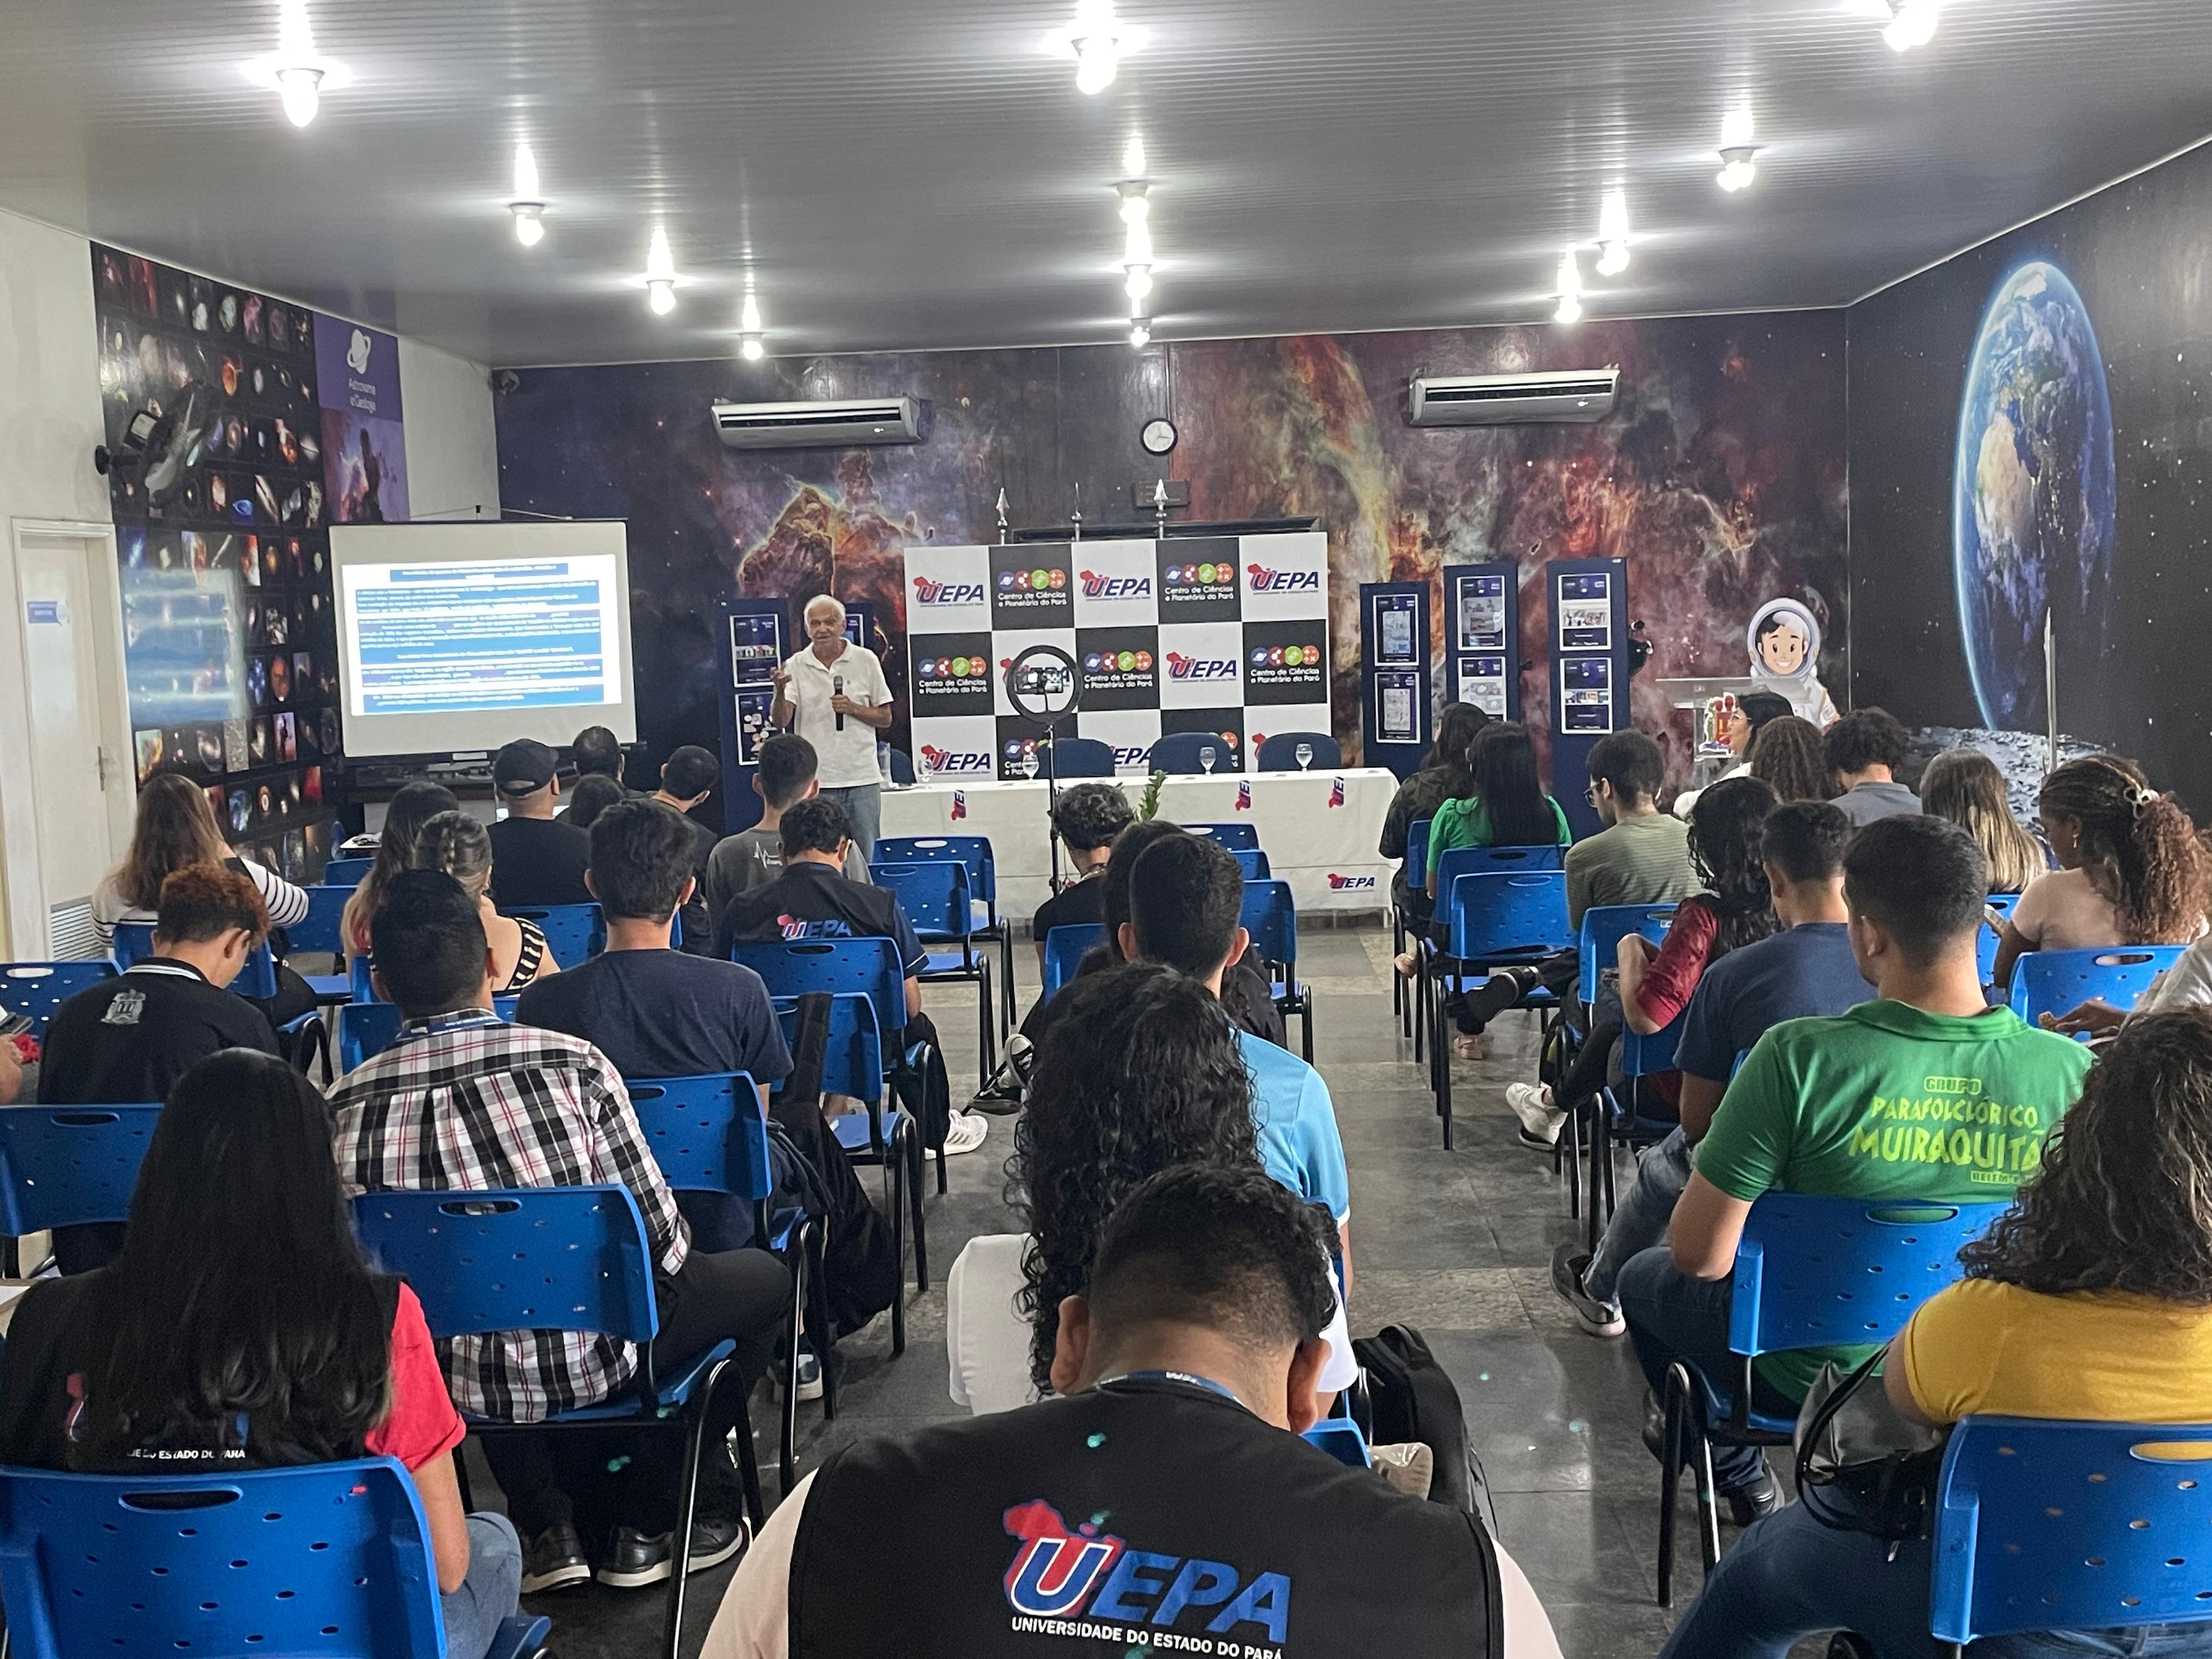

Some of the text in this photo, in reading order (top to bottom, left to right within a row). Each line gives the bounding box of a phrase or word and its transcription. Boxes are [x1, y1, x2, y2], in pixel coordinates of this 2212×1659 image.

[1082, 577, 1151, 597] UEPA
[1251, 571, 1318, 591] UEPA
[916, 583, 984, 603] UEPA
[1170, 659, 1237, 679] UEPA
[1330, 877, 1375, 889] UEPA
[782, 919, 853, 941] UEPA
[1926, 1077, 1980, 1094] GRUPO
[1870, 1096, 2038, 1129] PARAFOLCLÓRICO
[1848, 1124, 2045, 1172] MUIRAQUITÃ
[1010, 1537, 1291, 1644] UEPA
[1012, 1617, 1282, 1659] UNIVERSIDADE DO ESTADO DO PARÁ
